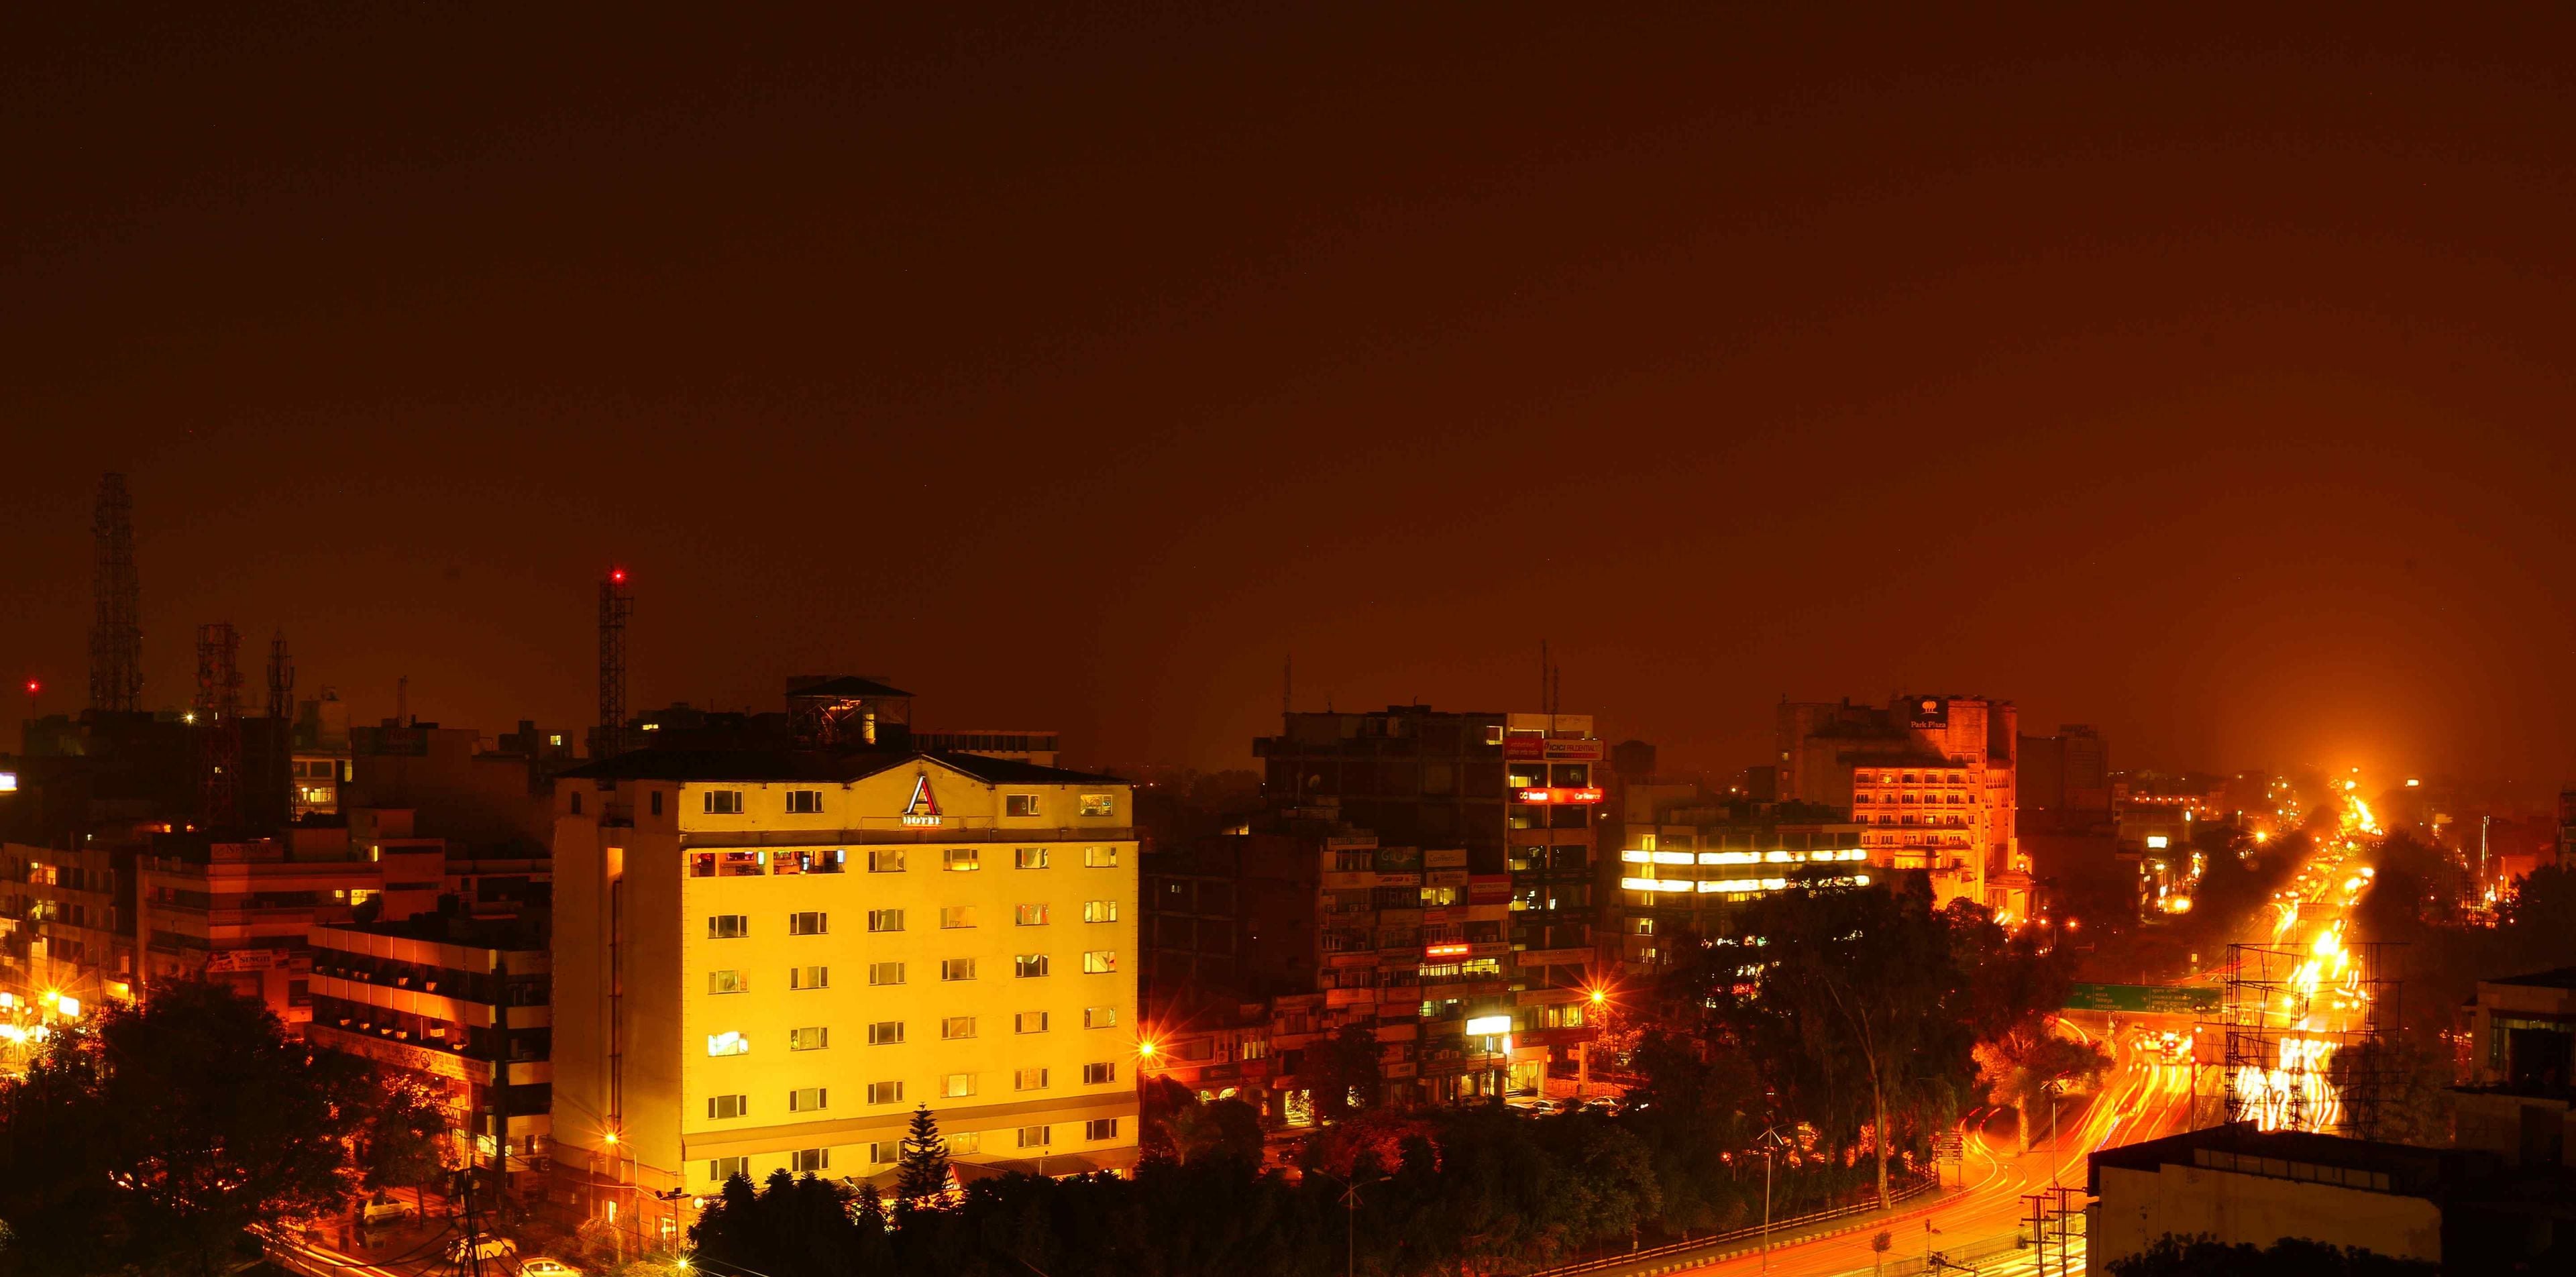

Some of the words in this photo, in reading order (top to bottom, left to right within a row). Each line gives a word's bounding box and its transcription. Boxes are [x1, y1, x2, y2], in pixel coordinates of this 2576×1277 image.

[1549, 744, 1566, 752] ICICI
[902, 774, 942, 816] A
[902, 816, 942, 826] HOTEL
